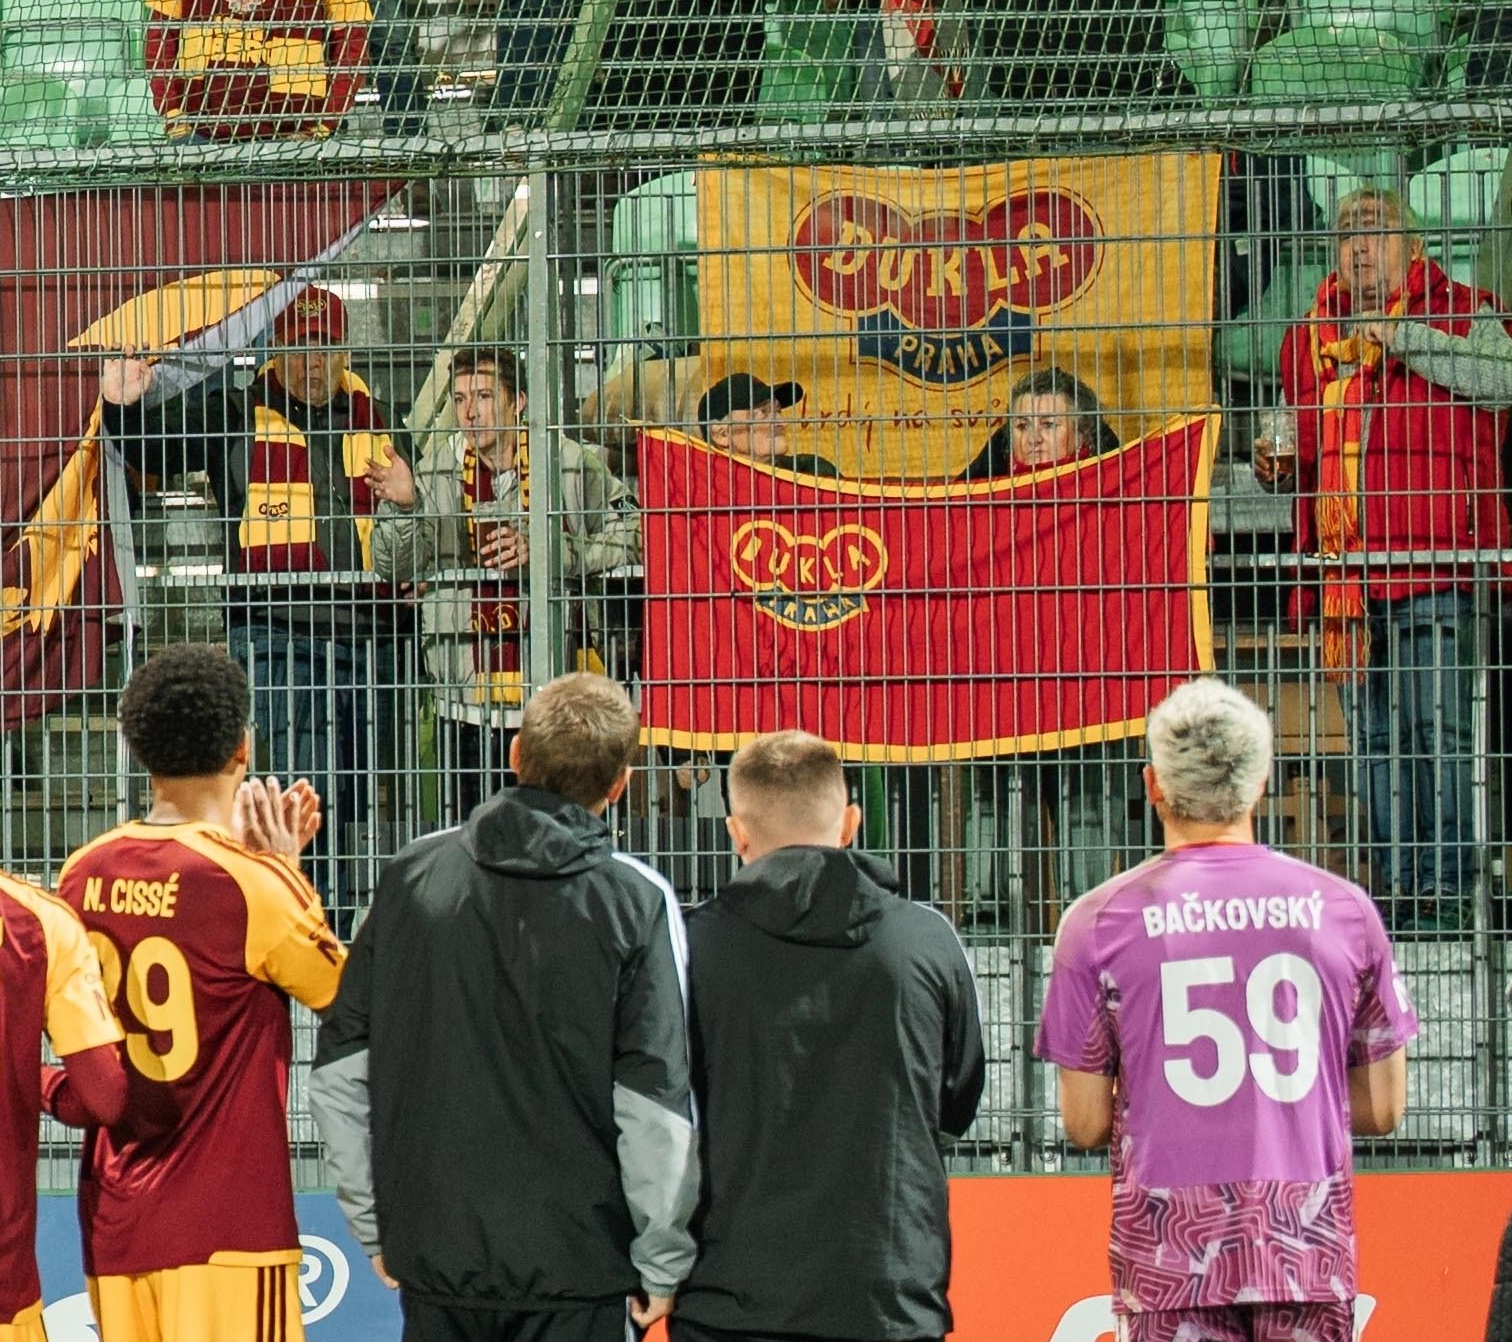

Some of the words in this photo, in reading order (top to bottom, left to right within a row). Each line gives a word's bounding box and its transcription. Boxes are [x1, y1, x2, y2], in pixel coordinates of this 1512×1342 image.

[822, 220, 1070, 297] DUKLA
[894, 335, 1005, 375] PRAHA
[894, 409, 931, 428] na
[83, 877, 106, 913] N.
[110, 872, 180, 918] CISSÉ
[1142, 889, 1324, 938] BAČKOVSKÝ
[1159, 952, 1323, 1107] 59
